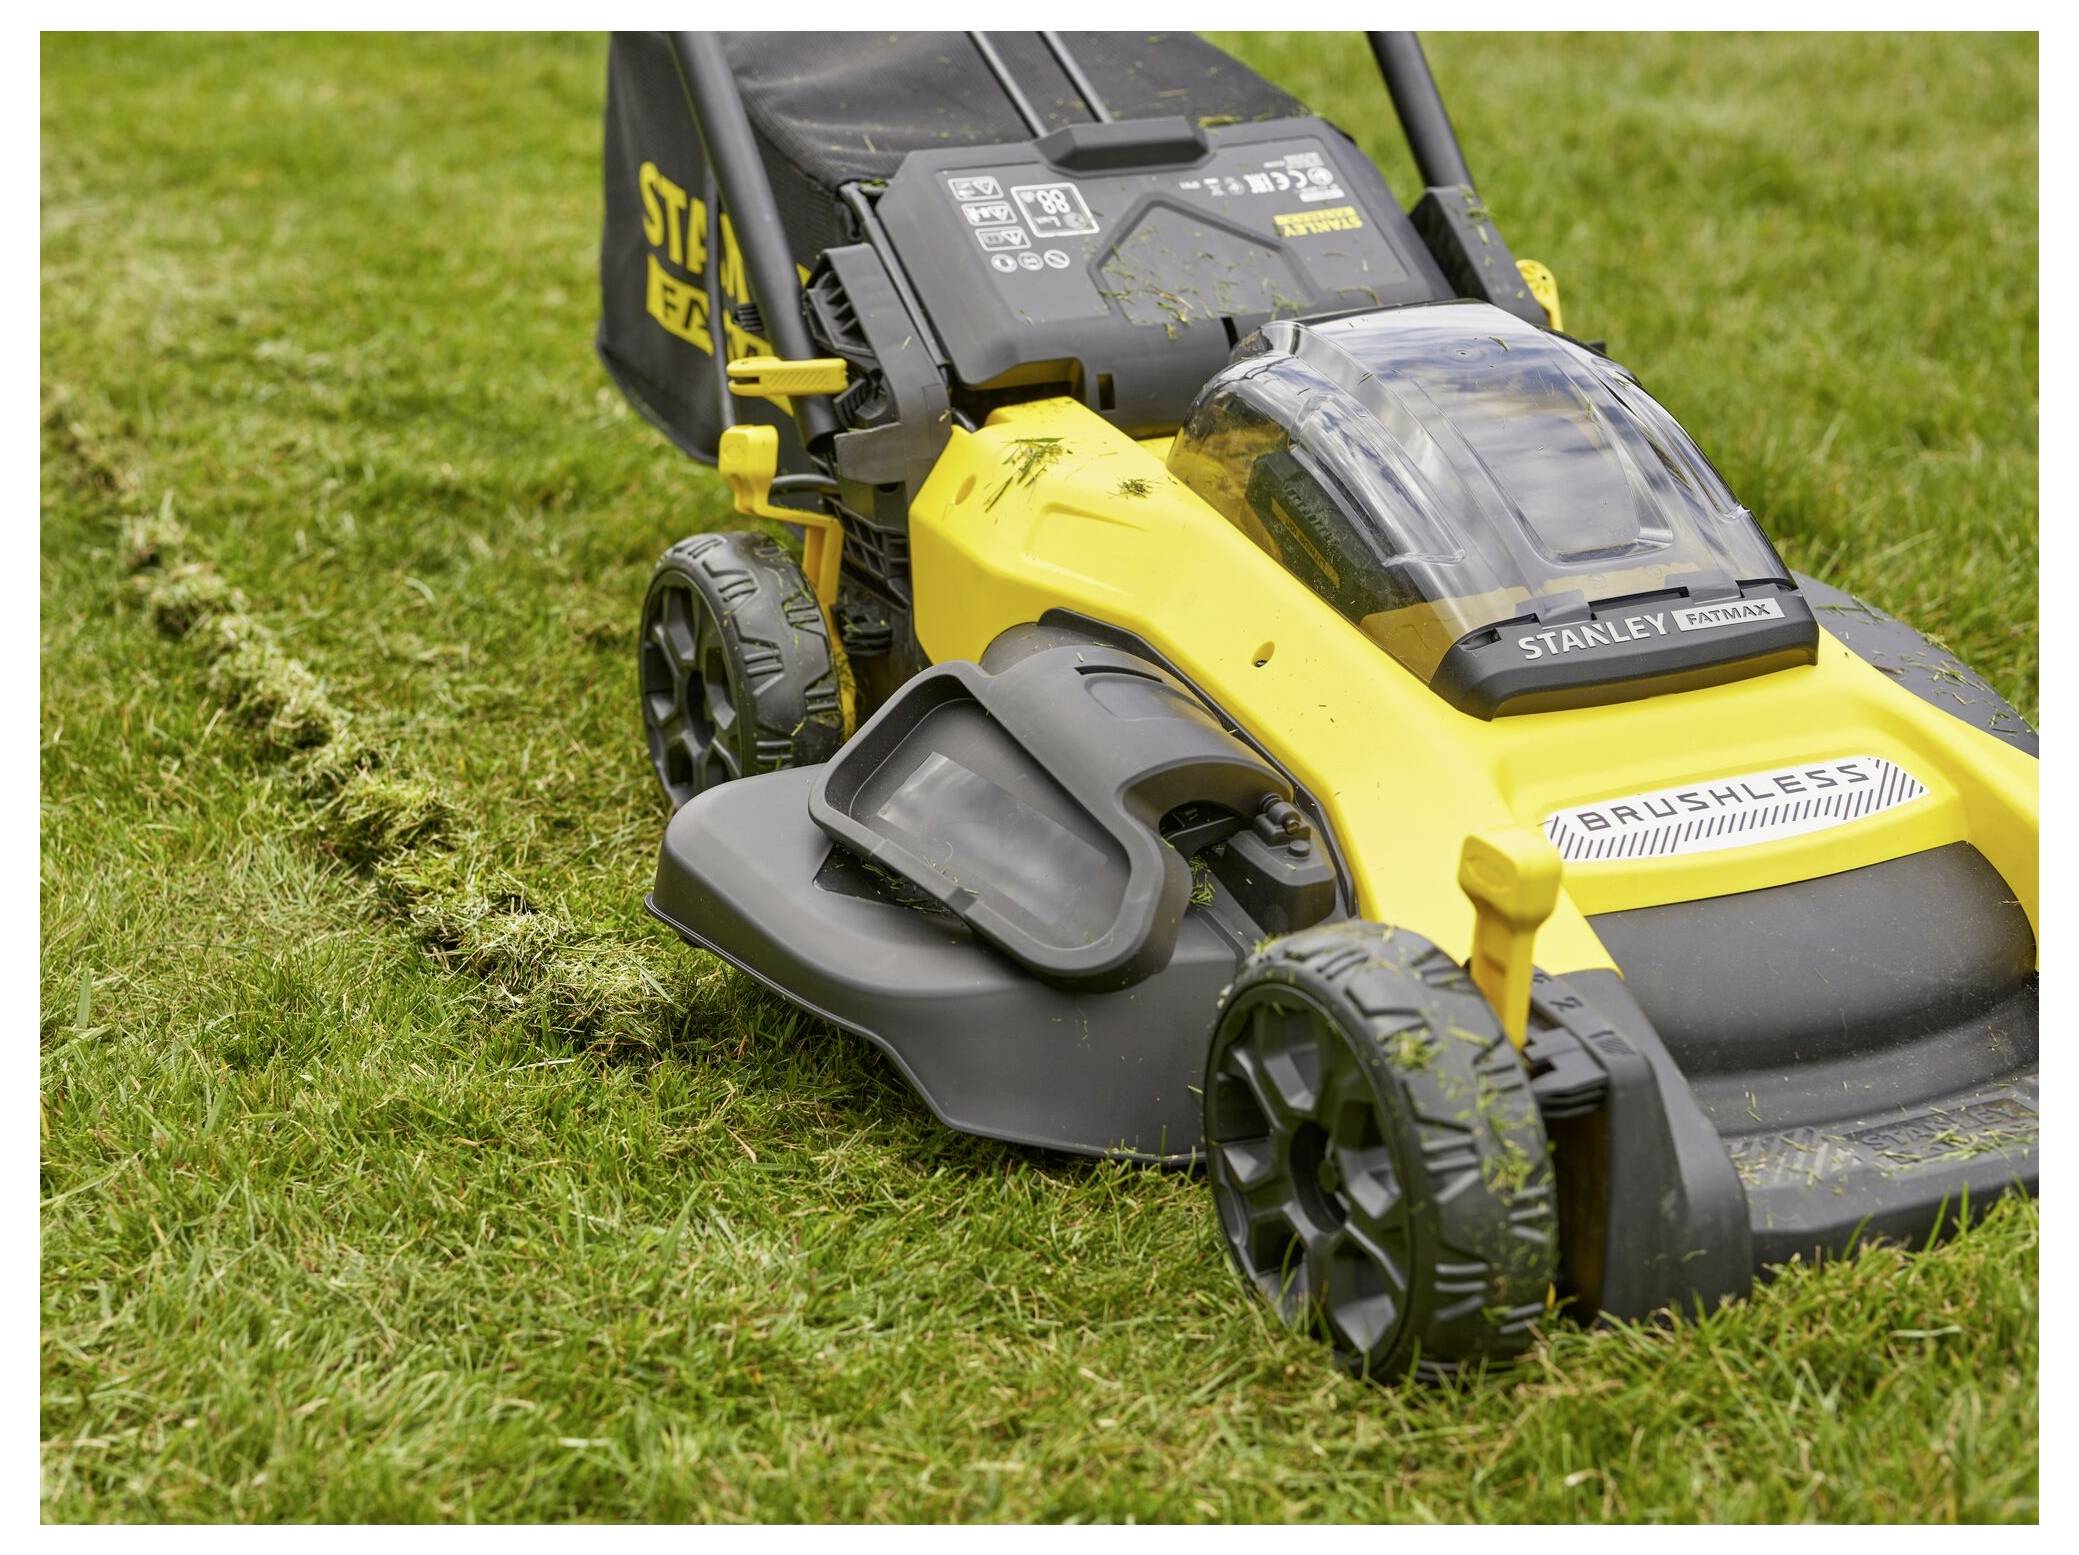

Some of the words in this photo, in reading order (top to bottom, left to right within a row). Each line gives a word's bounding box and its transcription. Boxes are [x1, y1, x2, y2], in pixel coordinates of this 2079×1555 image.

[1518, 613, 1668, 660] STANLEY
[1686, 603, 1771, 626] FATMAX
[1576, 764, 1870, 832] BRUSHLESS
